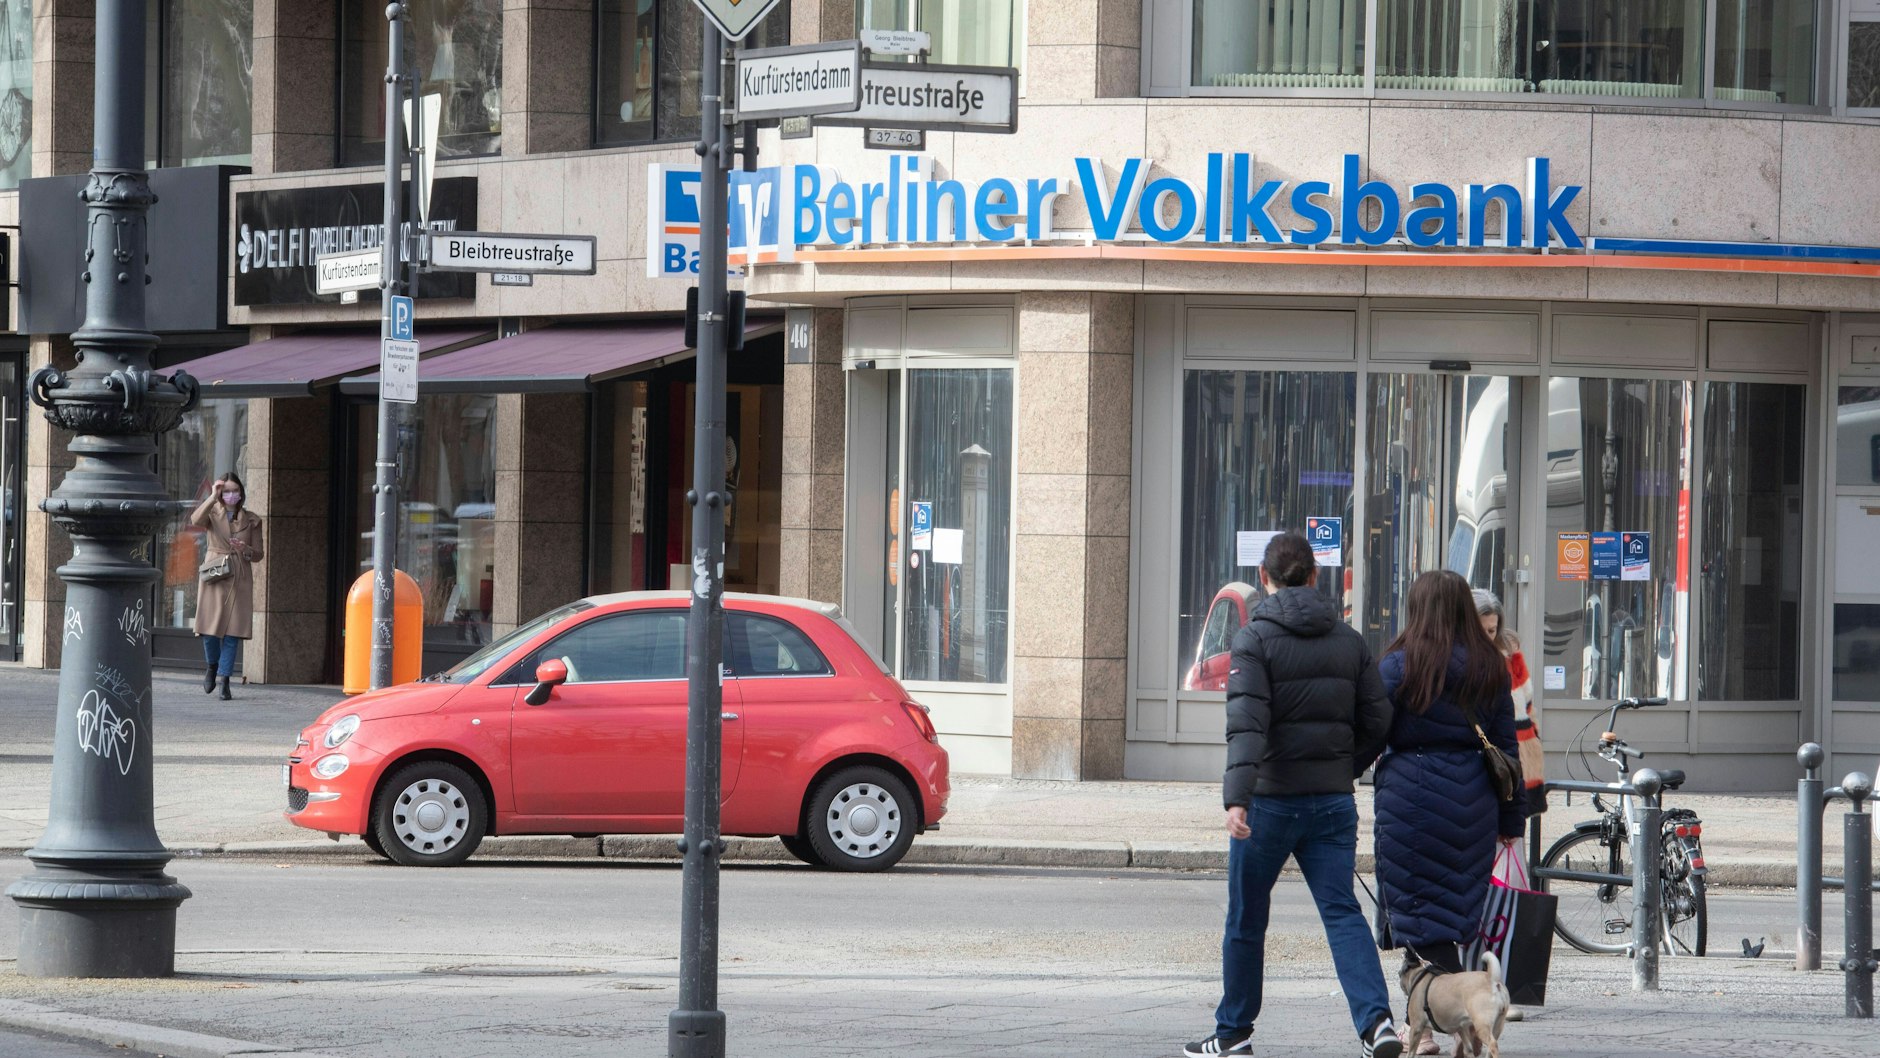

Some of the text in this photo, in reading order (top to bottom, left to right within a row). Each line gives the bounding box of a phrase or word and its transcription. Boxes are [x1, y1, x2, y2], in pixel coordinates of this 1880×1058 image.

[874, 34, 891, 42] Georg
[743, 60, 851, 97] Kurfürstendamm
[861, 79, 984, 116] treustraße
[794, 152, 1586, 249] Berliner Volksbank
[253, 227, 306, 269] DELFI
[449, 240, 574, 266] Bleibtreustraße
[322, 259, 379, 280] Kurfürstendamm
[396, 302, 408, 335] P
[790, 322, 808, 349] 46
